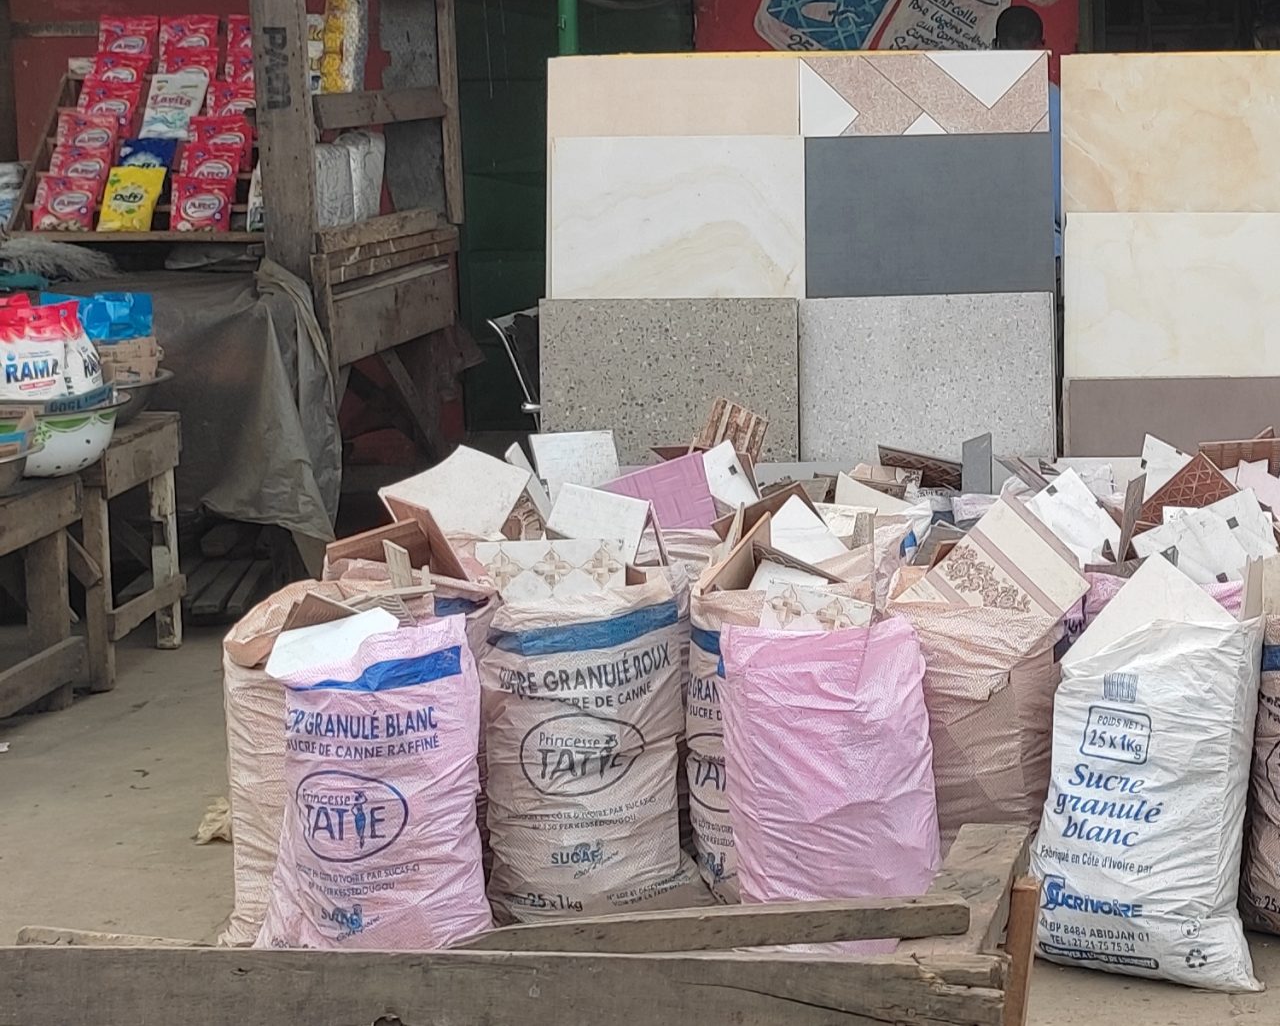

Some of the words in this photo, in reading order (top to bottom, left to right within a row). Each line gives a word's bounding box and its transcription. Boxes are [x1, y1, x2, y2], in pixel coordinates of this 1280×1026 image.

[543, 652, 630, 692] GRANULÉ
[632, 641, 671, 680] ROUX
[595, 695, 614, 708] DE
[617, 681, 653, 705] CANNE
[305, 710, 380, 740] GRANULÉ
[385, 706, 438, 738] BLANC
[1097, 715, 1122, 728] POIDS
[318, 743, 333, 757] DE
[335, 745, 384, 760] CANNE
[387, 733, 440, 757] RAFFINÉ
[539, 731, 600, 748] Princesse
[1088, 729, 1107, 749] 25
[1068, 763, 1145, 794] Sucre
[1053, 793, 1164, 824] granulé
[1061, 815, 1139, 847] blanc
[1040, 844, 1070, 864] Fabriqué
[1071, 854, 1080, 864] en
[1081, 853, 1100, 867] Côte
[1101, 856, 1135, 872] d'Ivoire
[1137, 864, 1153, 875] par
[1063, 924, 1087, 938] 8484
[1089, 928, 1135, 941] ABIDJAN
[1137, 932, 1150, 942] 01
